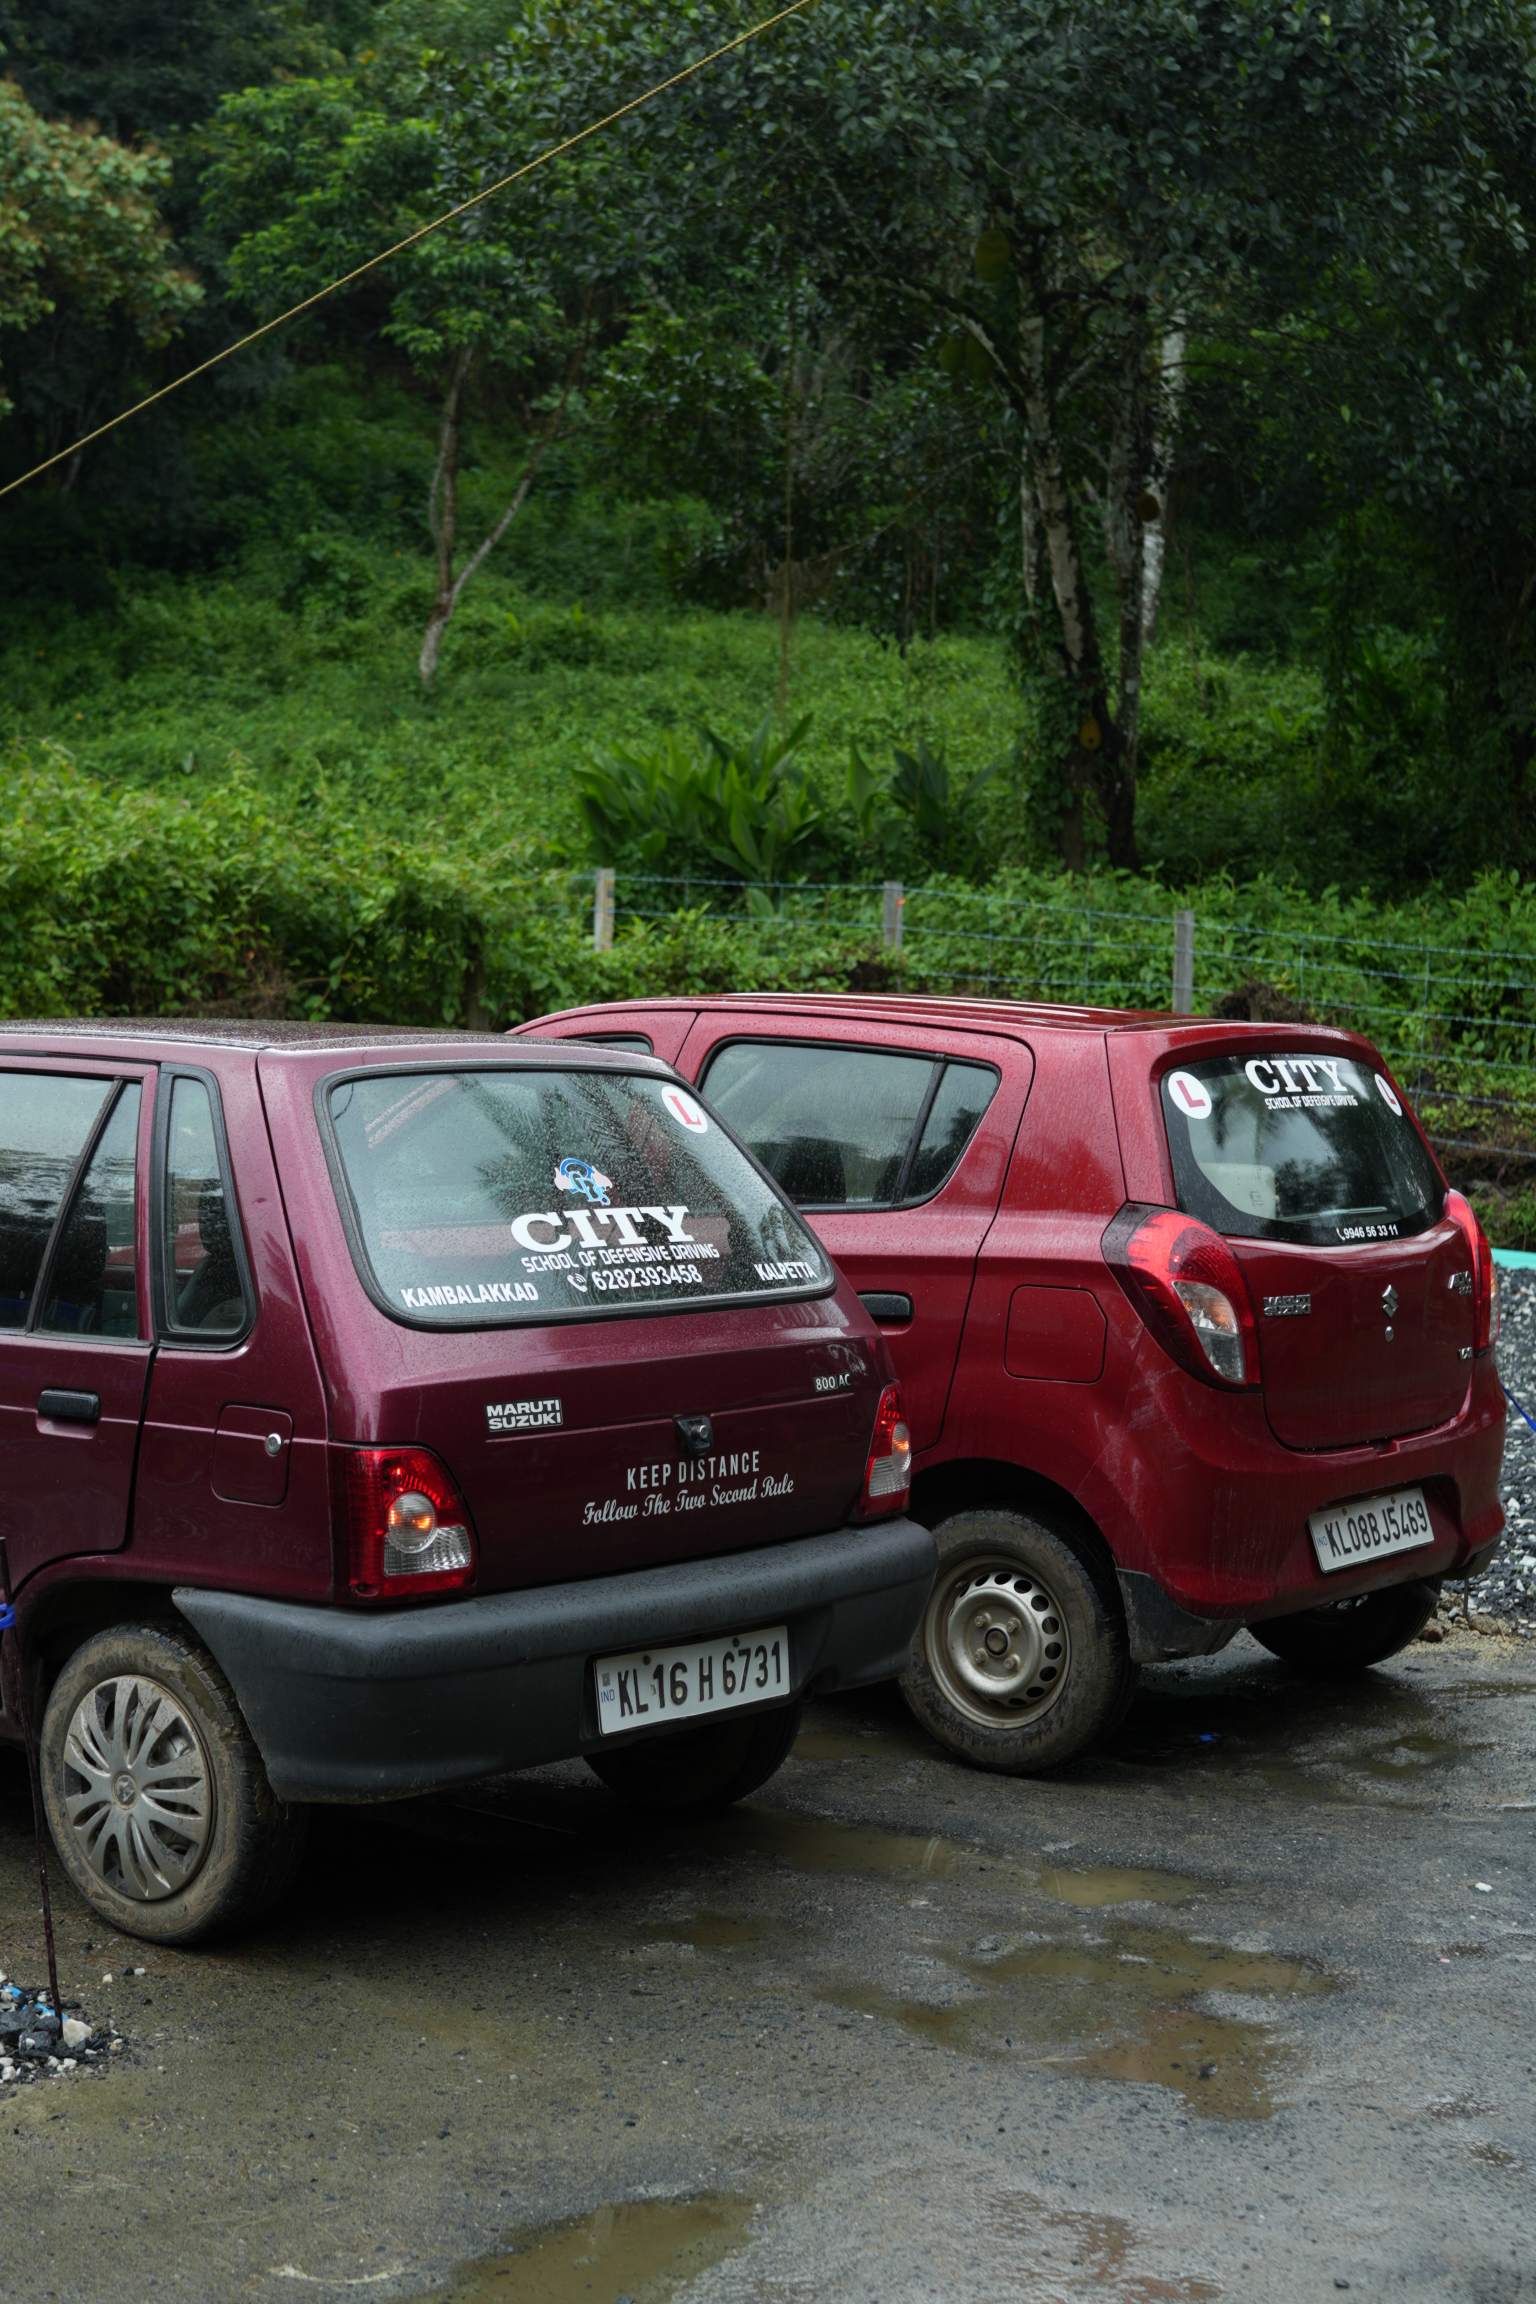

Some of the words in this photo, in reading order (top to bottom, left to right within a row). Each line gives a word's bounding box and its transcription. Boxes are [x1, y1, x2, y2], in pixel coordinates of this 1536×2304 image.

[1245, 1060, 1348, 1094] CITY
[1176, 1080, 1206, 1108] L
[1264, 1096, 1294, 1110] SCHOOL
[1291, 1096, 1302, 1107] OF
[668, 1094, 702, 1125] L
[510, 1205, 695, 1253] CITY
[1343, 1226, 1365, 1239] 9946
[1366, 1225, 1377, 1237] 56
[1377, 1225, 1388, 1236] 33
[1389, 1224, 1398, 1235] 11
[520, 1252, 579, 1273] SCHOOL
[578, 1250, 598, 1266] OF
[599, 1246, 674, 1265] DEFENSIVE
[673, 1243, 720, 1260] DRIVING
[753, 1261, 818, 1281] KALPETTA
[591, 1264, 703, 1291] 6282393458
[401, 1282, 539, 1308] KAMBALAKKAD
[815, 1376, 836, 1391] 800
[839, 1373, 851, 1387] AC
[486, 1399, 560, 1417] MARUTI
[488, 1412, 561, 1430] SUZUKI
[627, 1463, 671, 1491] KEEP
[678, 1450, 760, 1484] DISTANCE
[582, 1500, 638, 1526] Follow
[642, 1493, 671, 1517] The
[674, 1489, 706, 1512] Two
[710, 1478, 757, 1507] Second
[760, 1472, 794, 1498] Rule
[617, 1668, 649, 1718] KL
[653, 1661, 688, 1709] 16
[699, 1655, 714, 1702] H
[722, 1640, 782, 1696] 6731
[600, 1688, 616, 1703] IND
